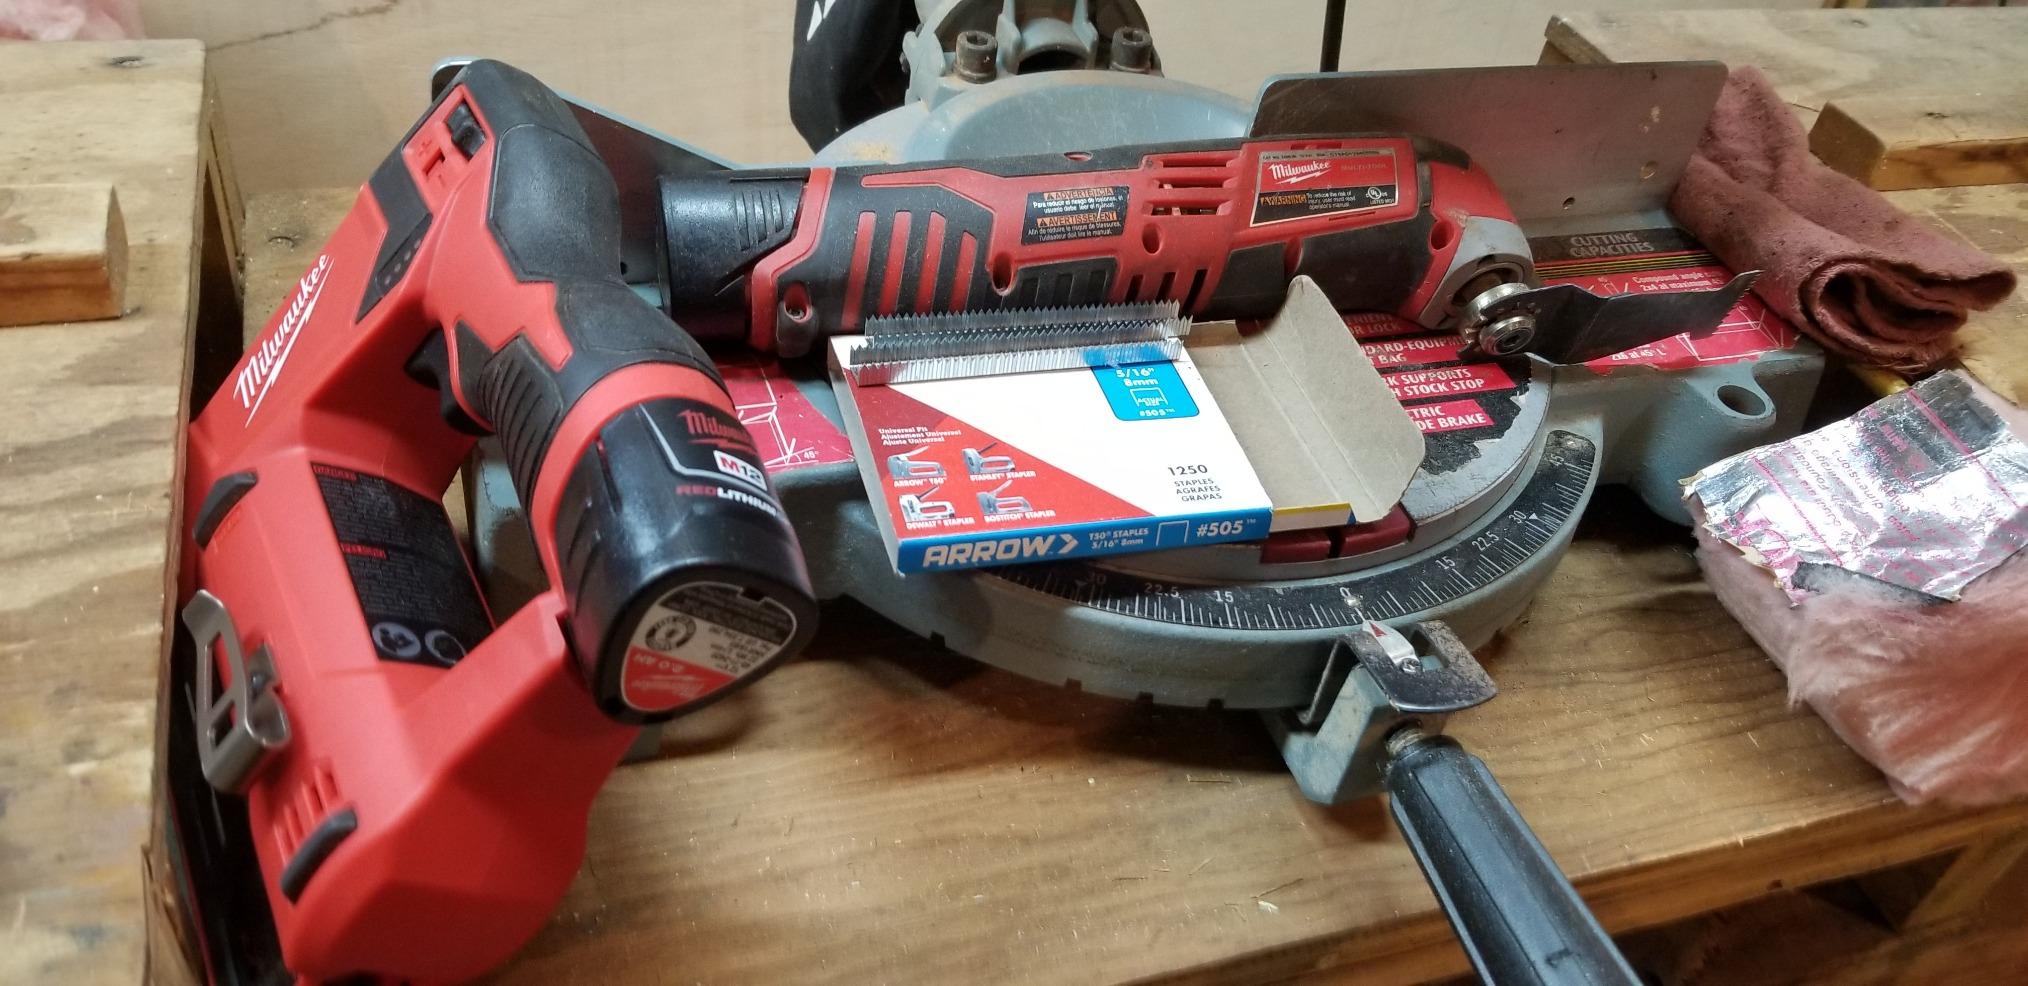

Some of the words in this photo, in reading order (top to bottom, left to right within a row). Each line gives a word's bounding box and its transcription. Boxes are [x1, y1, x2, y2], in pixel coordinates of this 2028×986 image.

[1268, 160, 1331, 180] Milwaukee
[1055, 187, 1113, 200] ADVERTENCIA
[1267, 194, 1307, 206] WARNING
[1570, 232, 1639, 247] CUTTING
[1569, 242, 1654, 258] CAPACITIES
[1632, 274, 1680, 285] Compound
[1681, 271, 1704, 281] angle
[1640, 282, 1659, 292] 2x4
[1669, 279, 1711, 290] maximum
[233, 254, 329, 408] Milwaukee
[1369, 322, 1401, 334] LOCK
[1378, 352, 1407, 364] BAG
[1115, 367, 1155, 379] 5/16"
[1400, 368, 1472, 386] SUPPORTS
[1123, 378, 1159, 388] 8mm
[1404, 382, 1449, 397] STOCK
[1450, 378, 1485, 392] STOP
[1437, 413, 1487, 429] BRAKE
[878, 426, 916, 435] Universal
[881, 431, 925, 441] Ajustement
[926, 429, 962, 438] Universal
[882, 437, 908, 446] Ajuste
[908, 436, 945, 445] Universal
[1549, 453, 1565, 468] 45
[1007, 470, 1036, 479] STAPLER
[1168, 464, 1208, 476] 1250
[1174, 478, 1214, 488] STAPLES
[1176, 485, 1221, 495] AGRAFES
[1181, 493, 1223, 502] GRAPAS
[1026, 509, 1056, 520] STAPLER
[1508, 510, 1528, 525] 30
[943, 517, 975, 527] STAPLER
[1113, 527, 1149, 538] STAPLES
[1121, 537, 1144, 547] 8mm
[1472, 530, 1500, 552] 22.5
[923, 534, 1056, 568] ARROW
[1436, 556, 1456, 570] 15
[1144, 582, 1180, 599] 22.5
[1213, 589, 1234, 603] 15
[1340, 586, 1351, 599] 0
